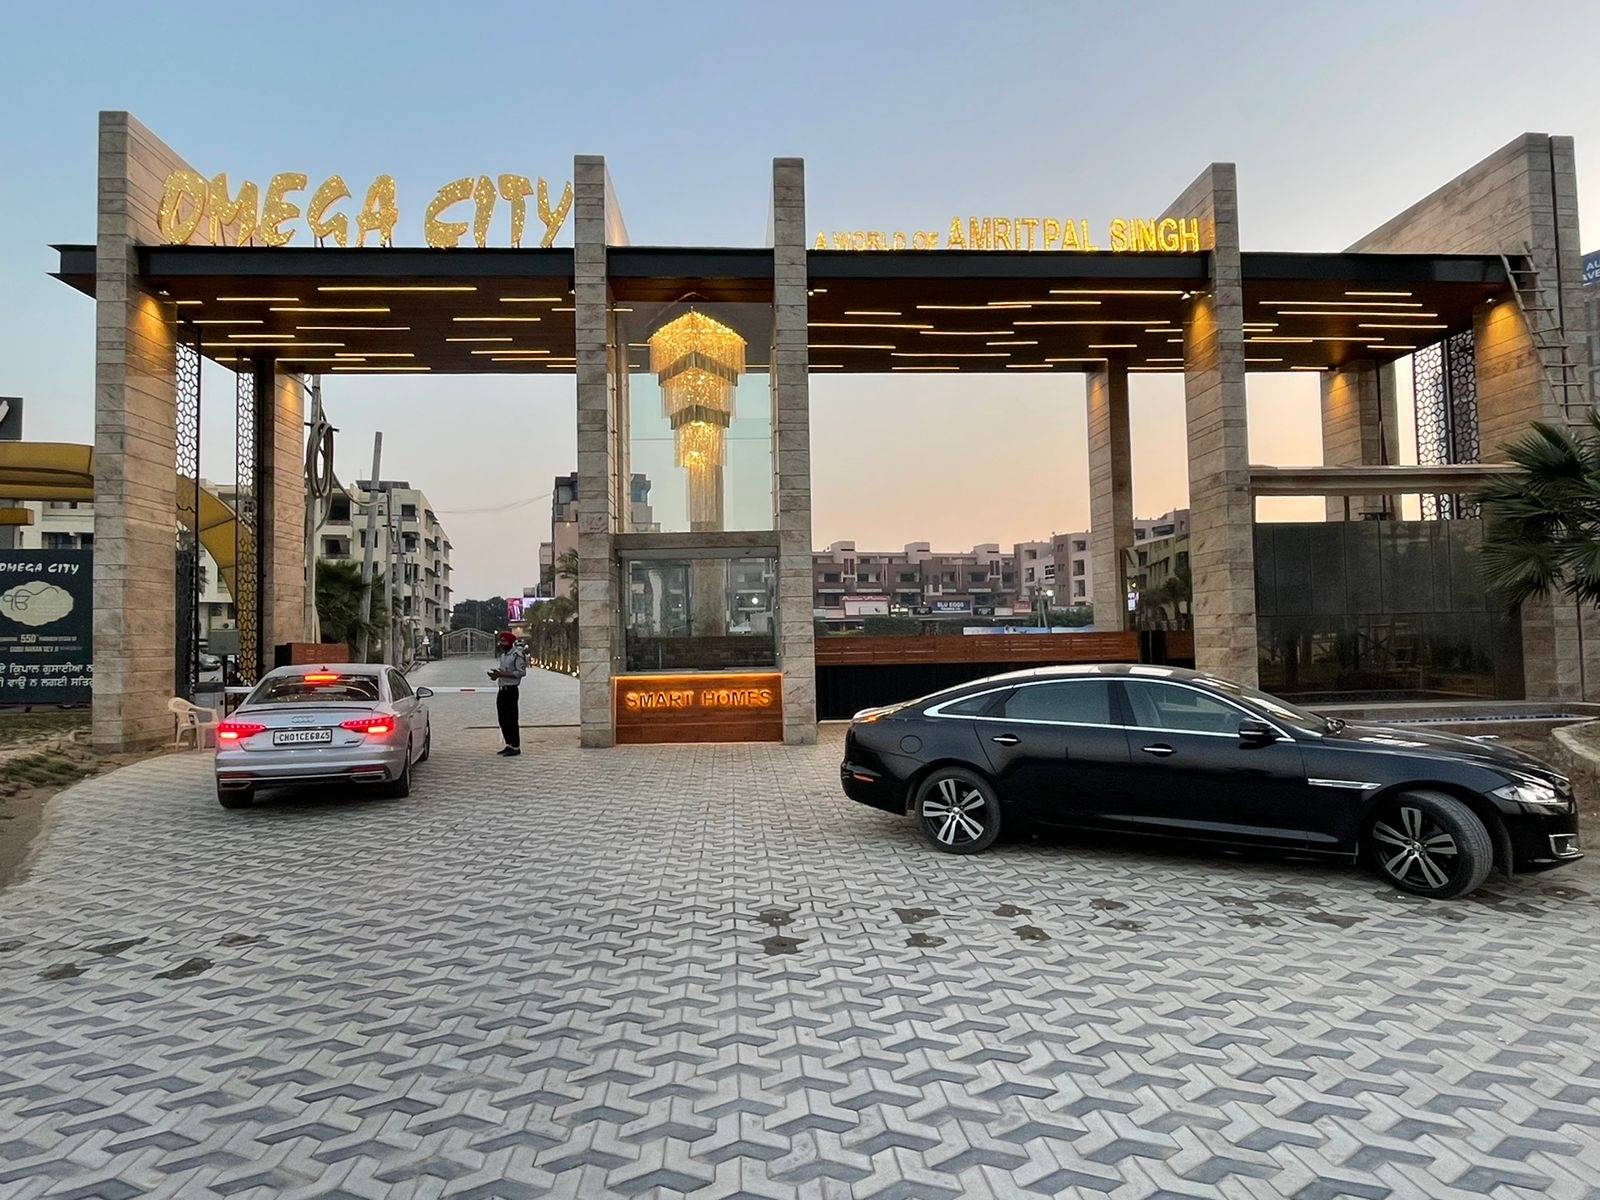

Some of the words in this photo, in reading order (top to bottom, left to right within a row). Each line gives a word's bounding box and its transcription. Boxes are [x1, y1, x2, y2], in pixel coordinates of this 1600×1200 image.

[157, 170, 399, 248] OMEGA
[424, 174, 574, 248] CITY
[814, 229, 828, 250] A
[832, 230, 907, 251] WORLD
[912, 231, 940, 250] OF
[947, 216, 1099, 251] AMRITPAL
[1110, 217, 1201, 252] SINGH
[0, 562, 43, 573] OMEGA
[47, 563, 79, 575] CITY
[20, 633, 37, 643] 550
[626, 691, 695, 708] SMART
[702, 689, 773, 706] HOMES
[279, 731, 330, 742] CH01CE6845
